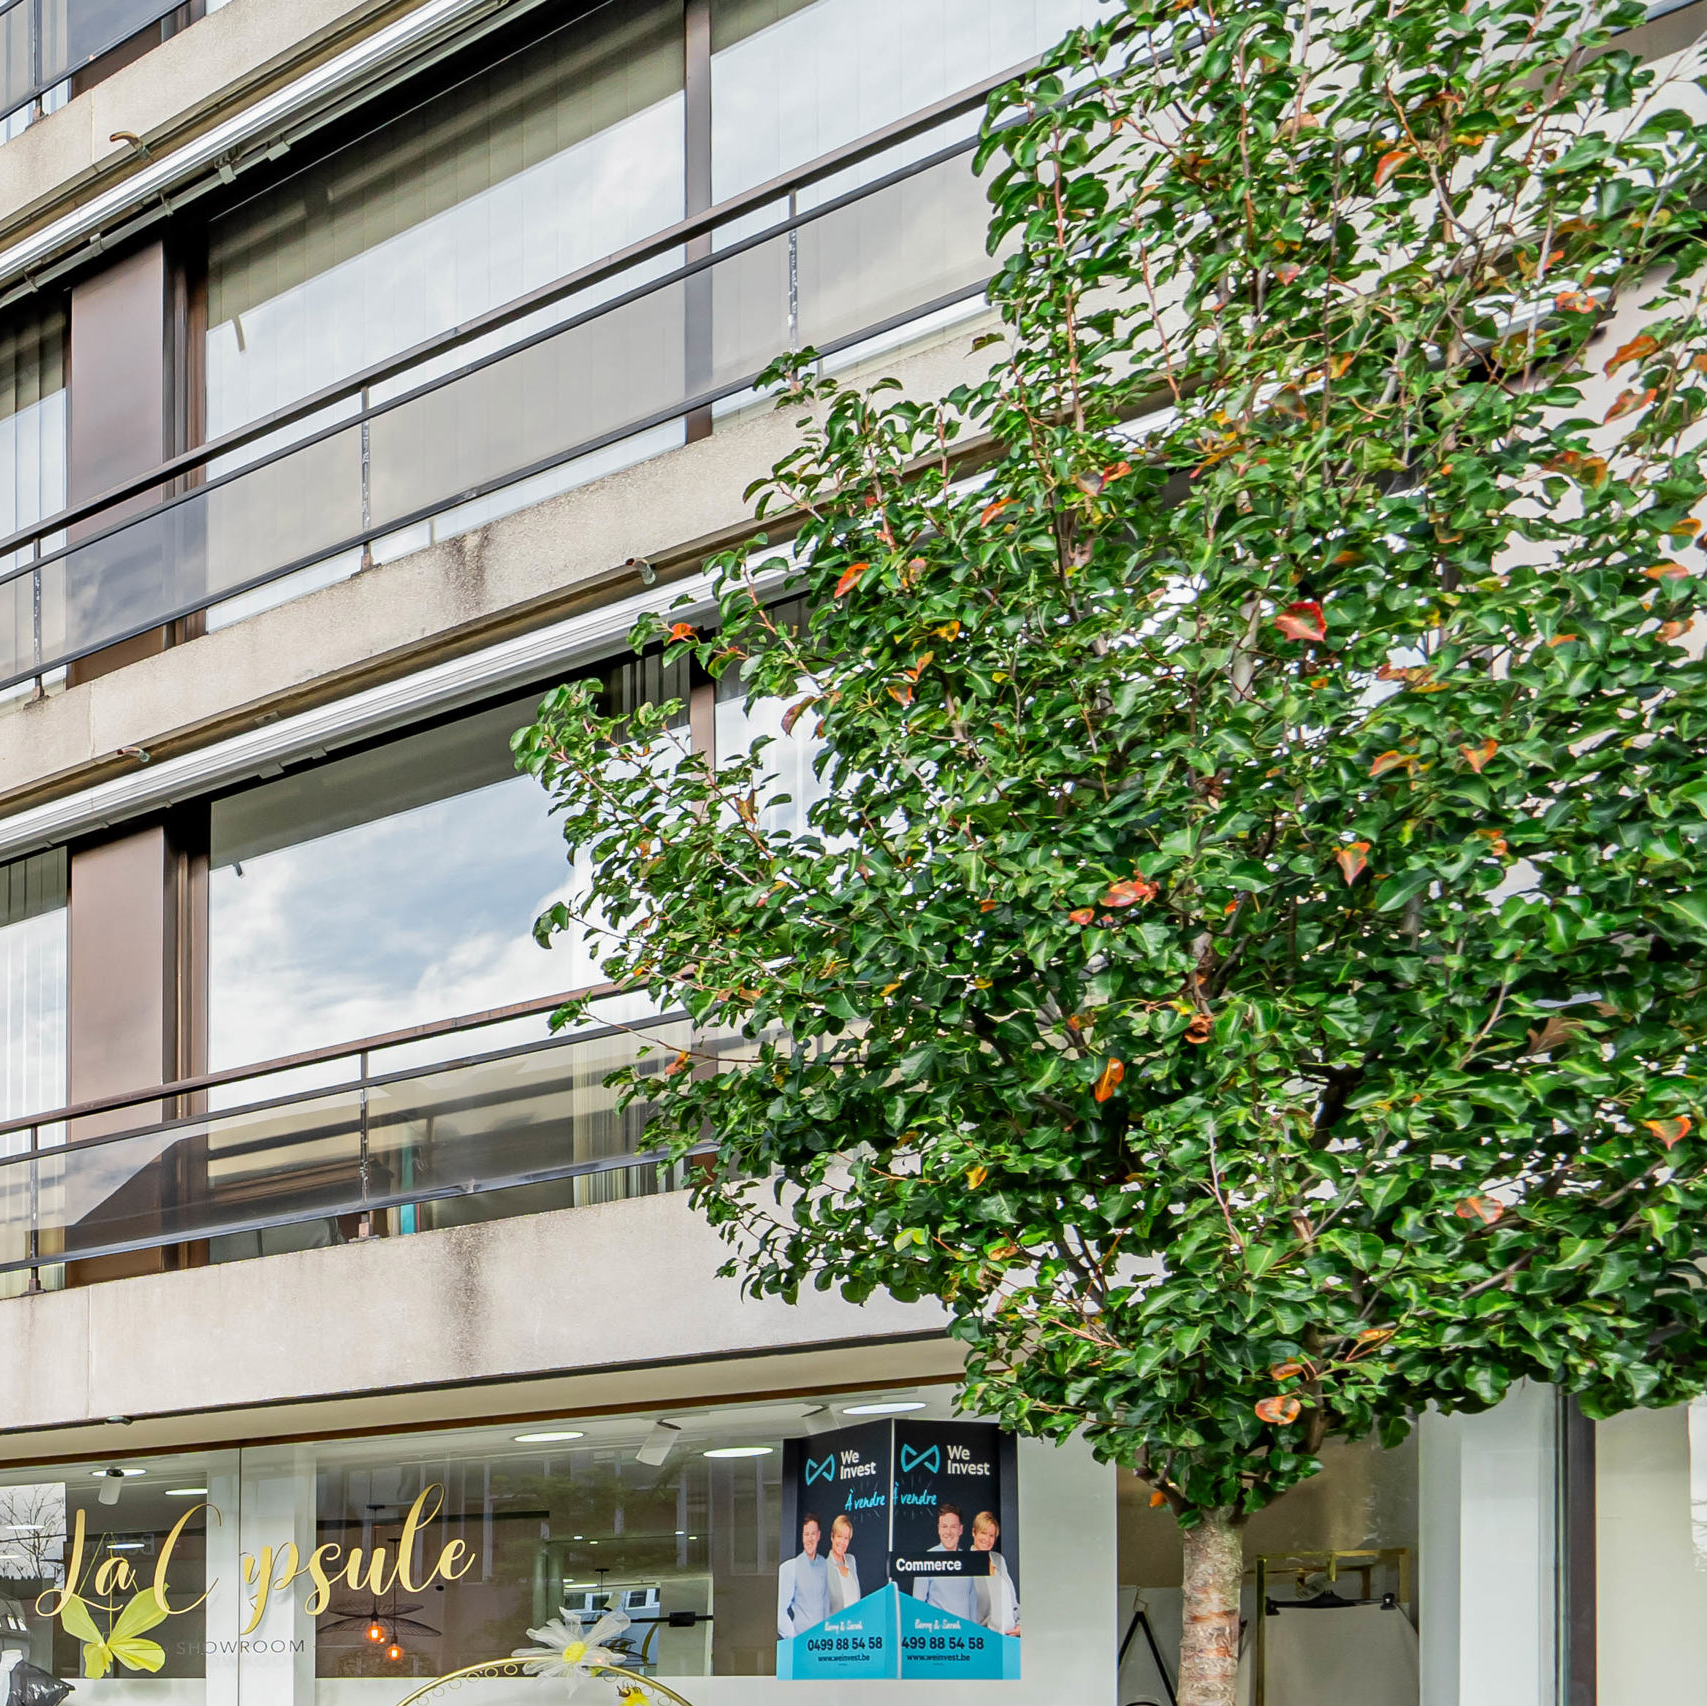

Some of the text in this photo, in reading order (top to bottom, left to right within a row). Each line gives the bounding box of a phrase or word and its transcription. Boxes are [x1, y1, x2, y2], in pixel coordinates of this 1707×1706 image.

[840, 1450, 860, 1464] We
[946, 1445, 970, 1460] We
[840, 1461, 877, 1480] Invest
[946, 1460, 991, 1476] Invest
[845, 1489, 886, 1511] À vendre
[900, 1489, 937, 1505] vendre
[35, 1508, 136, 1617] La
[896, 1558, 962, 1572] Commerce
[177, 1640, 305, 1655] SHOWROOM
[807, 1637, 883, 1651] 0499 88 54 58
[901, 1637, 984, 1650] 499 88 54 58
[817, 1653, 871, 1662] www.weinvest.be
[907, 1653, 970, 1662] www.weinvest.be
